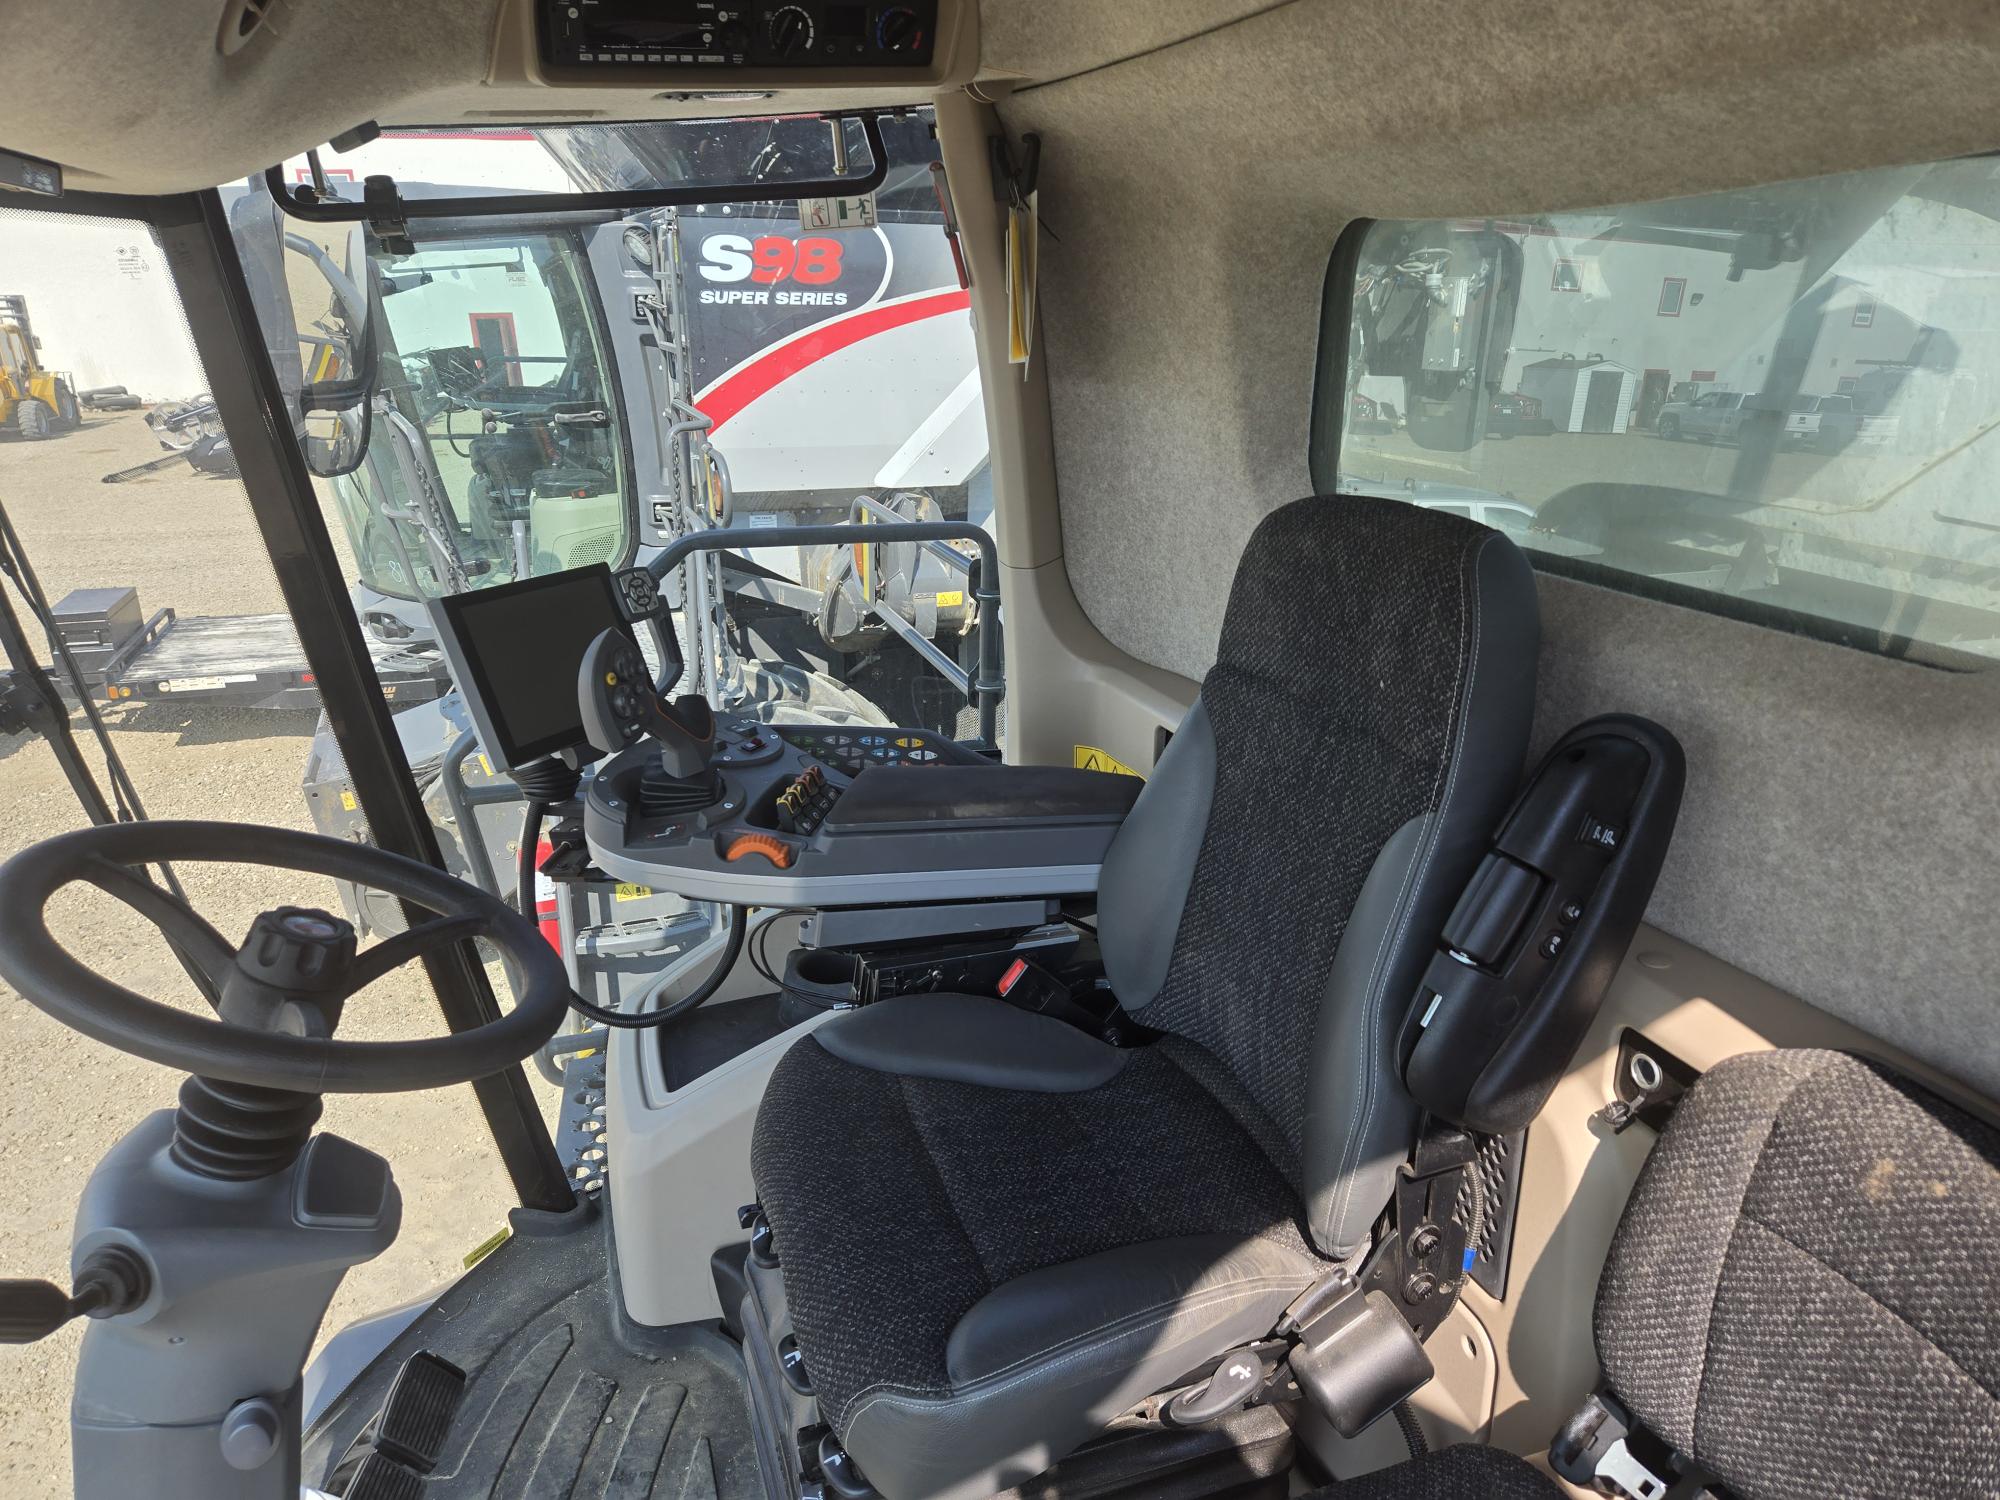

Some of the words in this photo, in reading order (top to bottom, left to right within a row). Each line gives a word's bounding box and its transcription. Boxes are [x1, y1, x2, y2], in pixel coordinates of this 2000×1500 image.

[699, 234, 843, 284] S98
[700, 290, 769, 305] SUPER
[775, 291, 848, 305] SERIES
